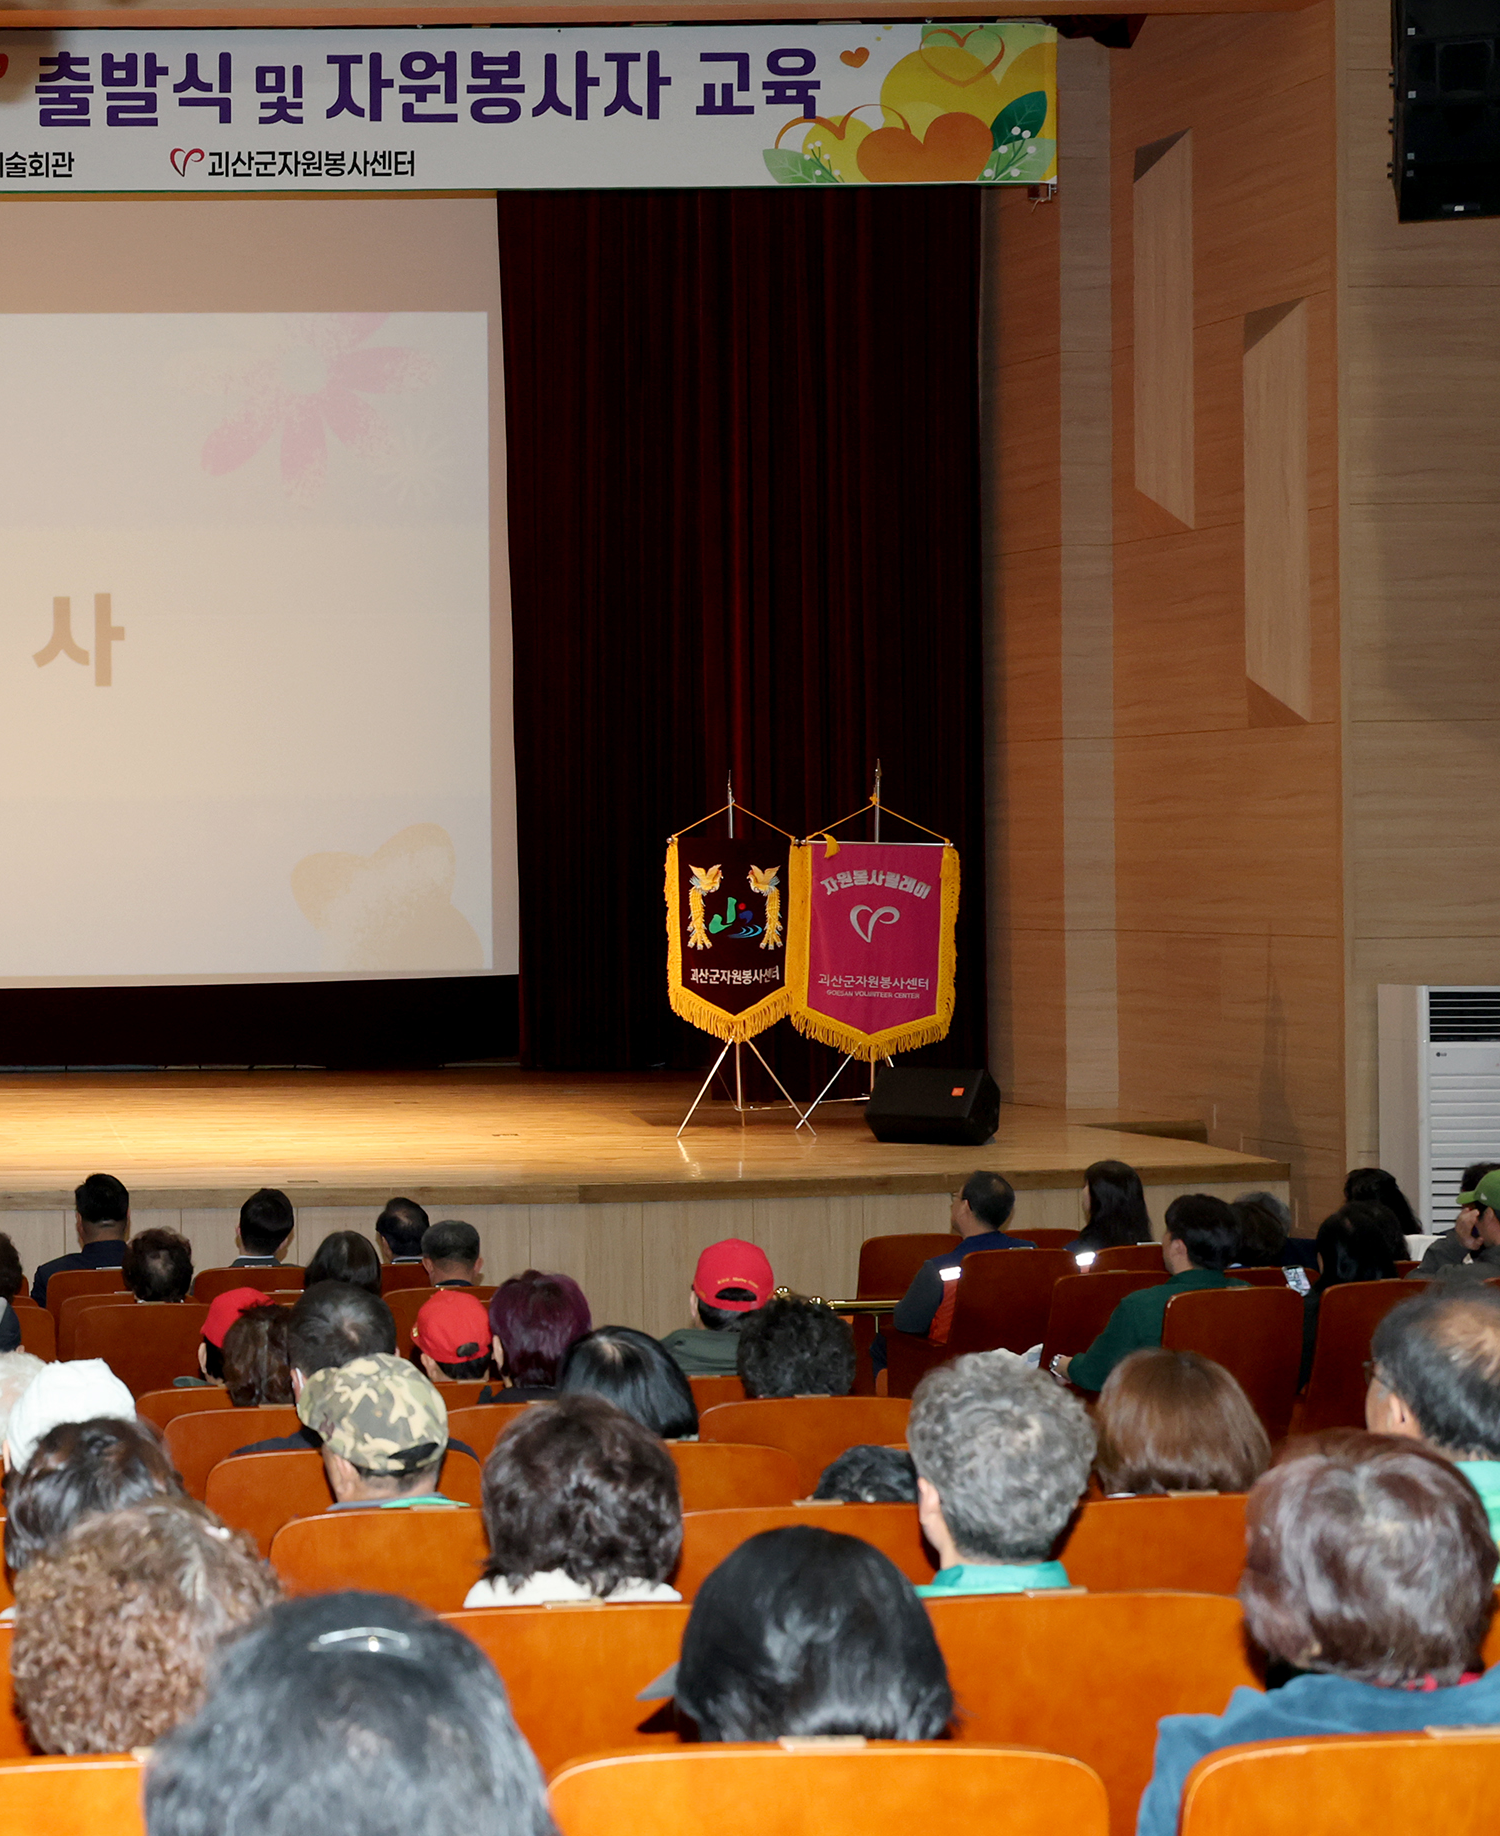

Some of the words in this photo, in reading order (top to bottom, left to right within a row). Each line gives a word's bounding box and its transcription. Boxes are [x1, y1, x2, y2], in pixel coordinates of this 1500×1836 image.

[34, 51, 233, 127] 출발식
[255, 64, 304, 125] 및
[326, 49, 672, 124] 자원봉사자
[695, 48, 821, 119] 교육
[207, 150, 415, 178] 괴산군자원봉사센터
[820, 869, 932, 899] 자원봉사릴레이
[690, 965, 780, 985] 괴산군자원봉사센터
[818, 973, 930, 991] 괴산군자원봉사센터
[826, 989, 853, 997] GOESAN
